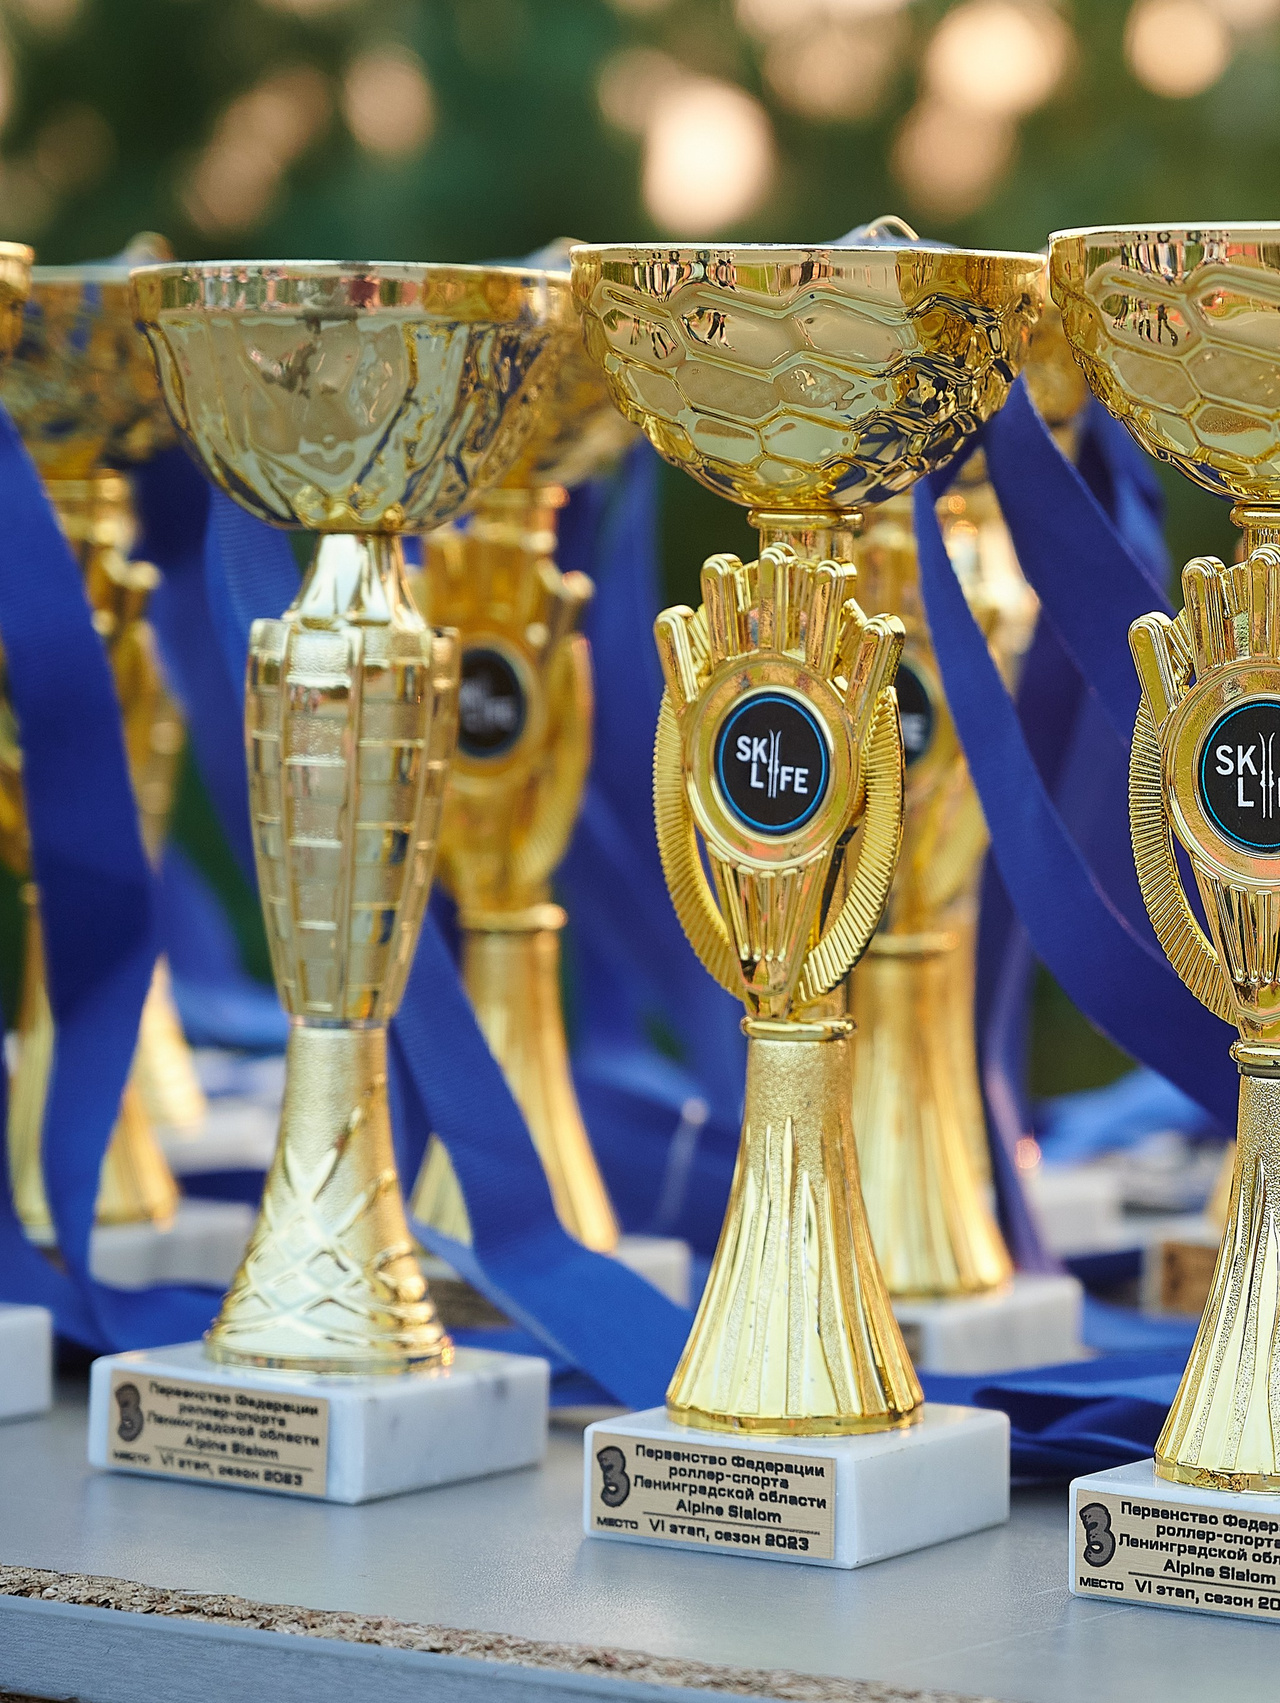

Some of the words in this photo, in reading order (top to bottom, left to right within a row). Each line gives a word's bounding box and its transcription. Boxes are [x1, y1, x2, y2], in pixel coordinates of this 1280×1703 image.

[185, 1434, 227, 1451] Alpine
[232, 1441, 279, 1460] Slalom
[636, 1444, 727, 1467] Первенство
[731, 1456, 825, 1477] Федерации
[264, 1470, 303, 1486] 2023
[597, 1446, 630, 1507] 3
[669, 1465, 789, 1489] роллер-спорта
[634, 1475, 754, 1500] Ленинградской
[759, 1490, 826, 1509] области
[676, 1499, 724, 1516] Alpine
[728, 1506, 782, 1523] Slalom
[1121, 1502, 1218, 1525] Первенство
[649, 1519, 664, 1532] VI
[670, 1523, 709, 1542] этап,
[715, 1529, 760, 1545] сезон
[765, 1534, 809, 1551] 2023
[1079, 1502, 1116, 1567] 3
[1119, 1534, 1247, 1561] Ленинградской
[1079, 1577, 1124, 1591] МЕСТО
[1163, 1559, 1215, 1577] Alpine
[1219, 1567, 1276, 1585] Slalom
[1135, 1579, 1151, 1593] VI
[1156, 1584, 1199, 1604] этап,
[1205, 1591, 1253, 1608] сезон
